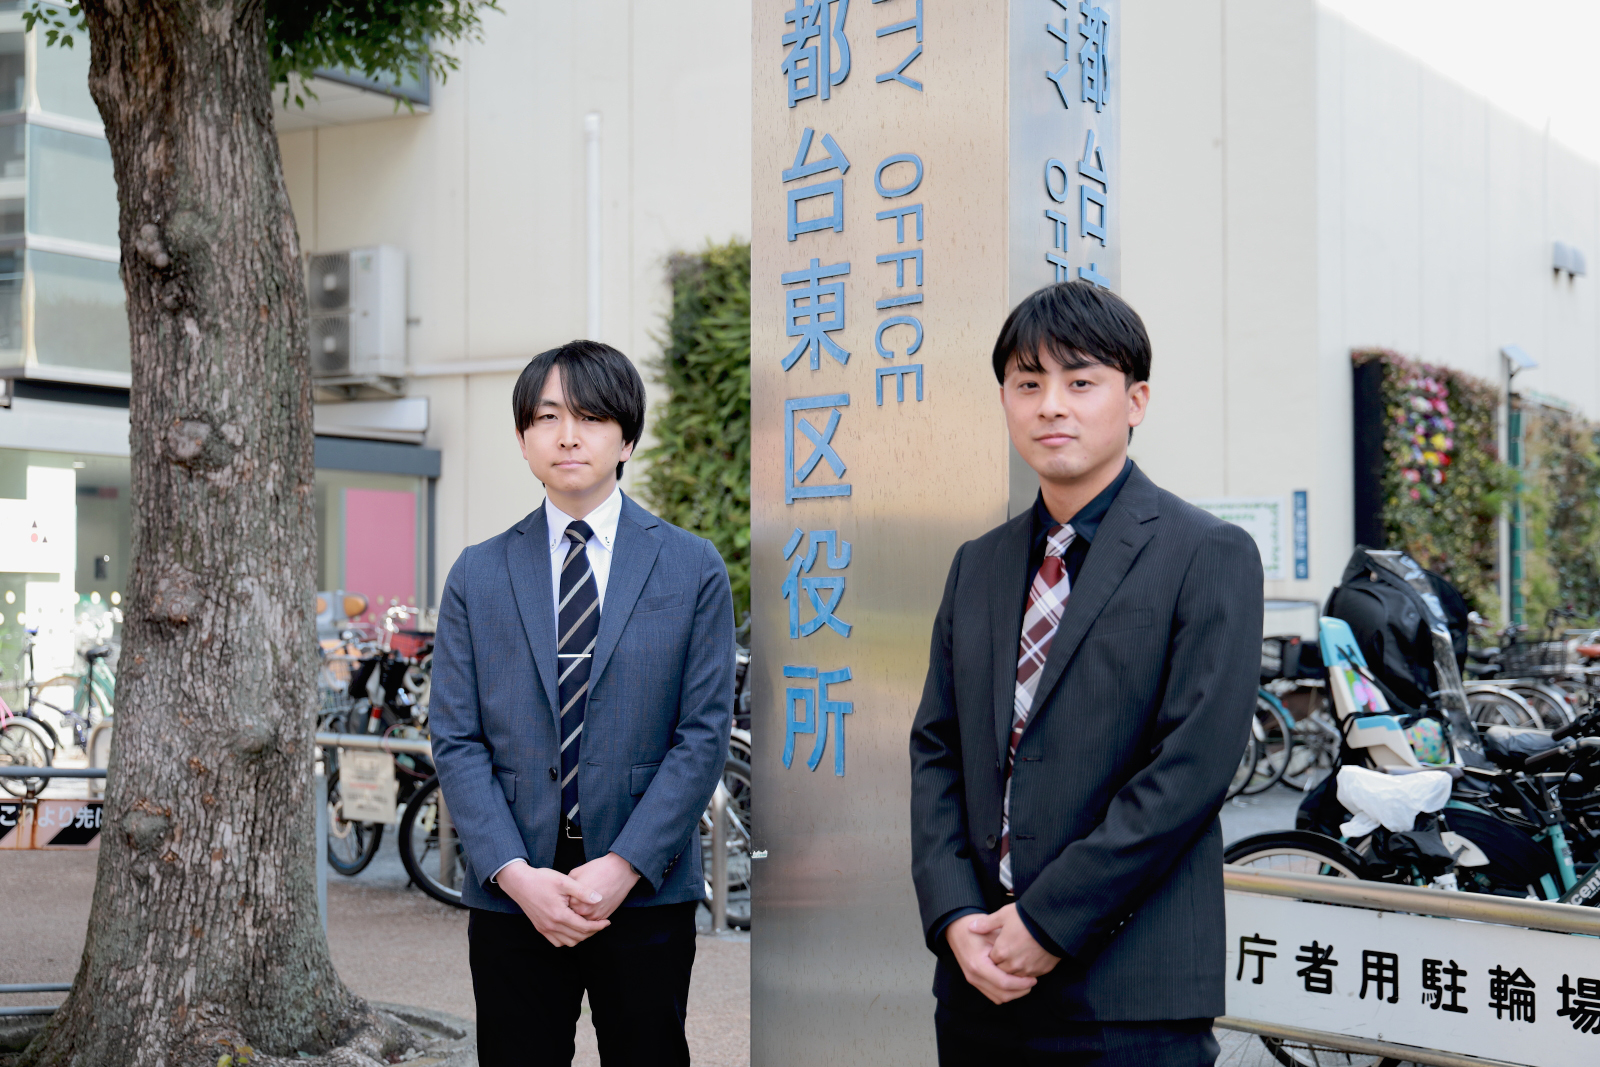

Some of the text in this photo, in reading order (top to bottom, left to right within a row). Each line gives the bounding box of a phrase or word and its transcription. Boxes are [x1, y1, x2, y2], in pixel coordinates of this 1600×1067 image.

[872, 0, 923, 406] TY OFFICE
[781, 0, 853, 777] 都台東区役所
[1236, 932, 1600, 1035] 庁者用駐輪場
[1566, 869, 1600, 906] cent
